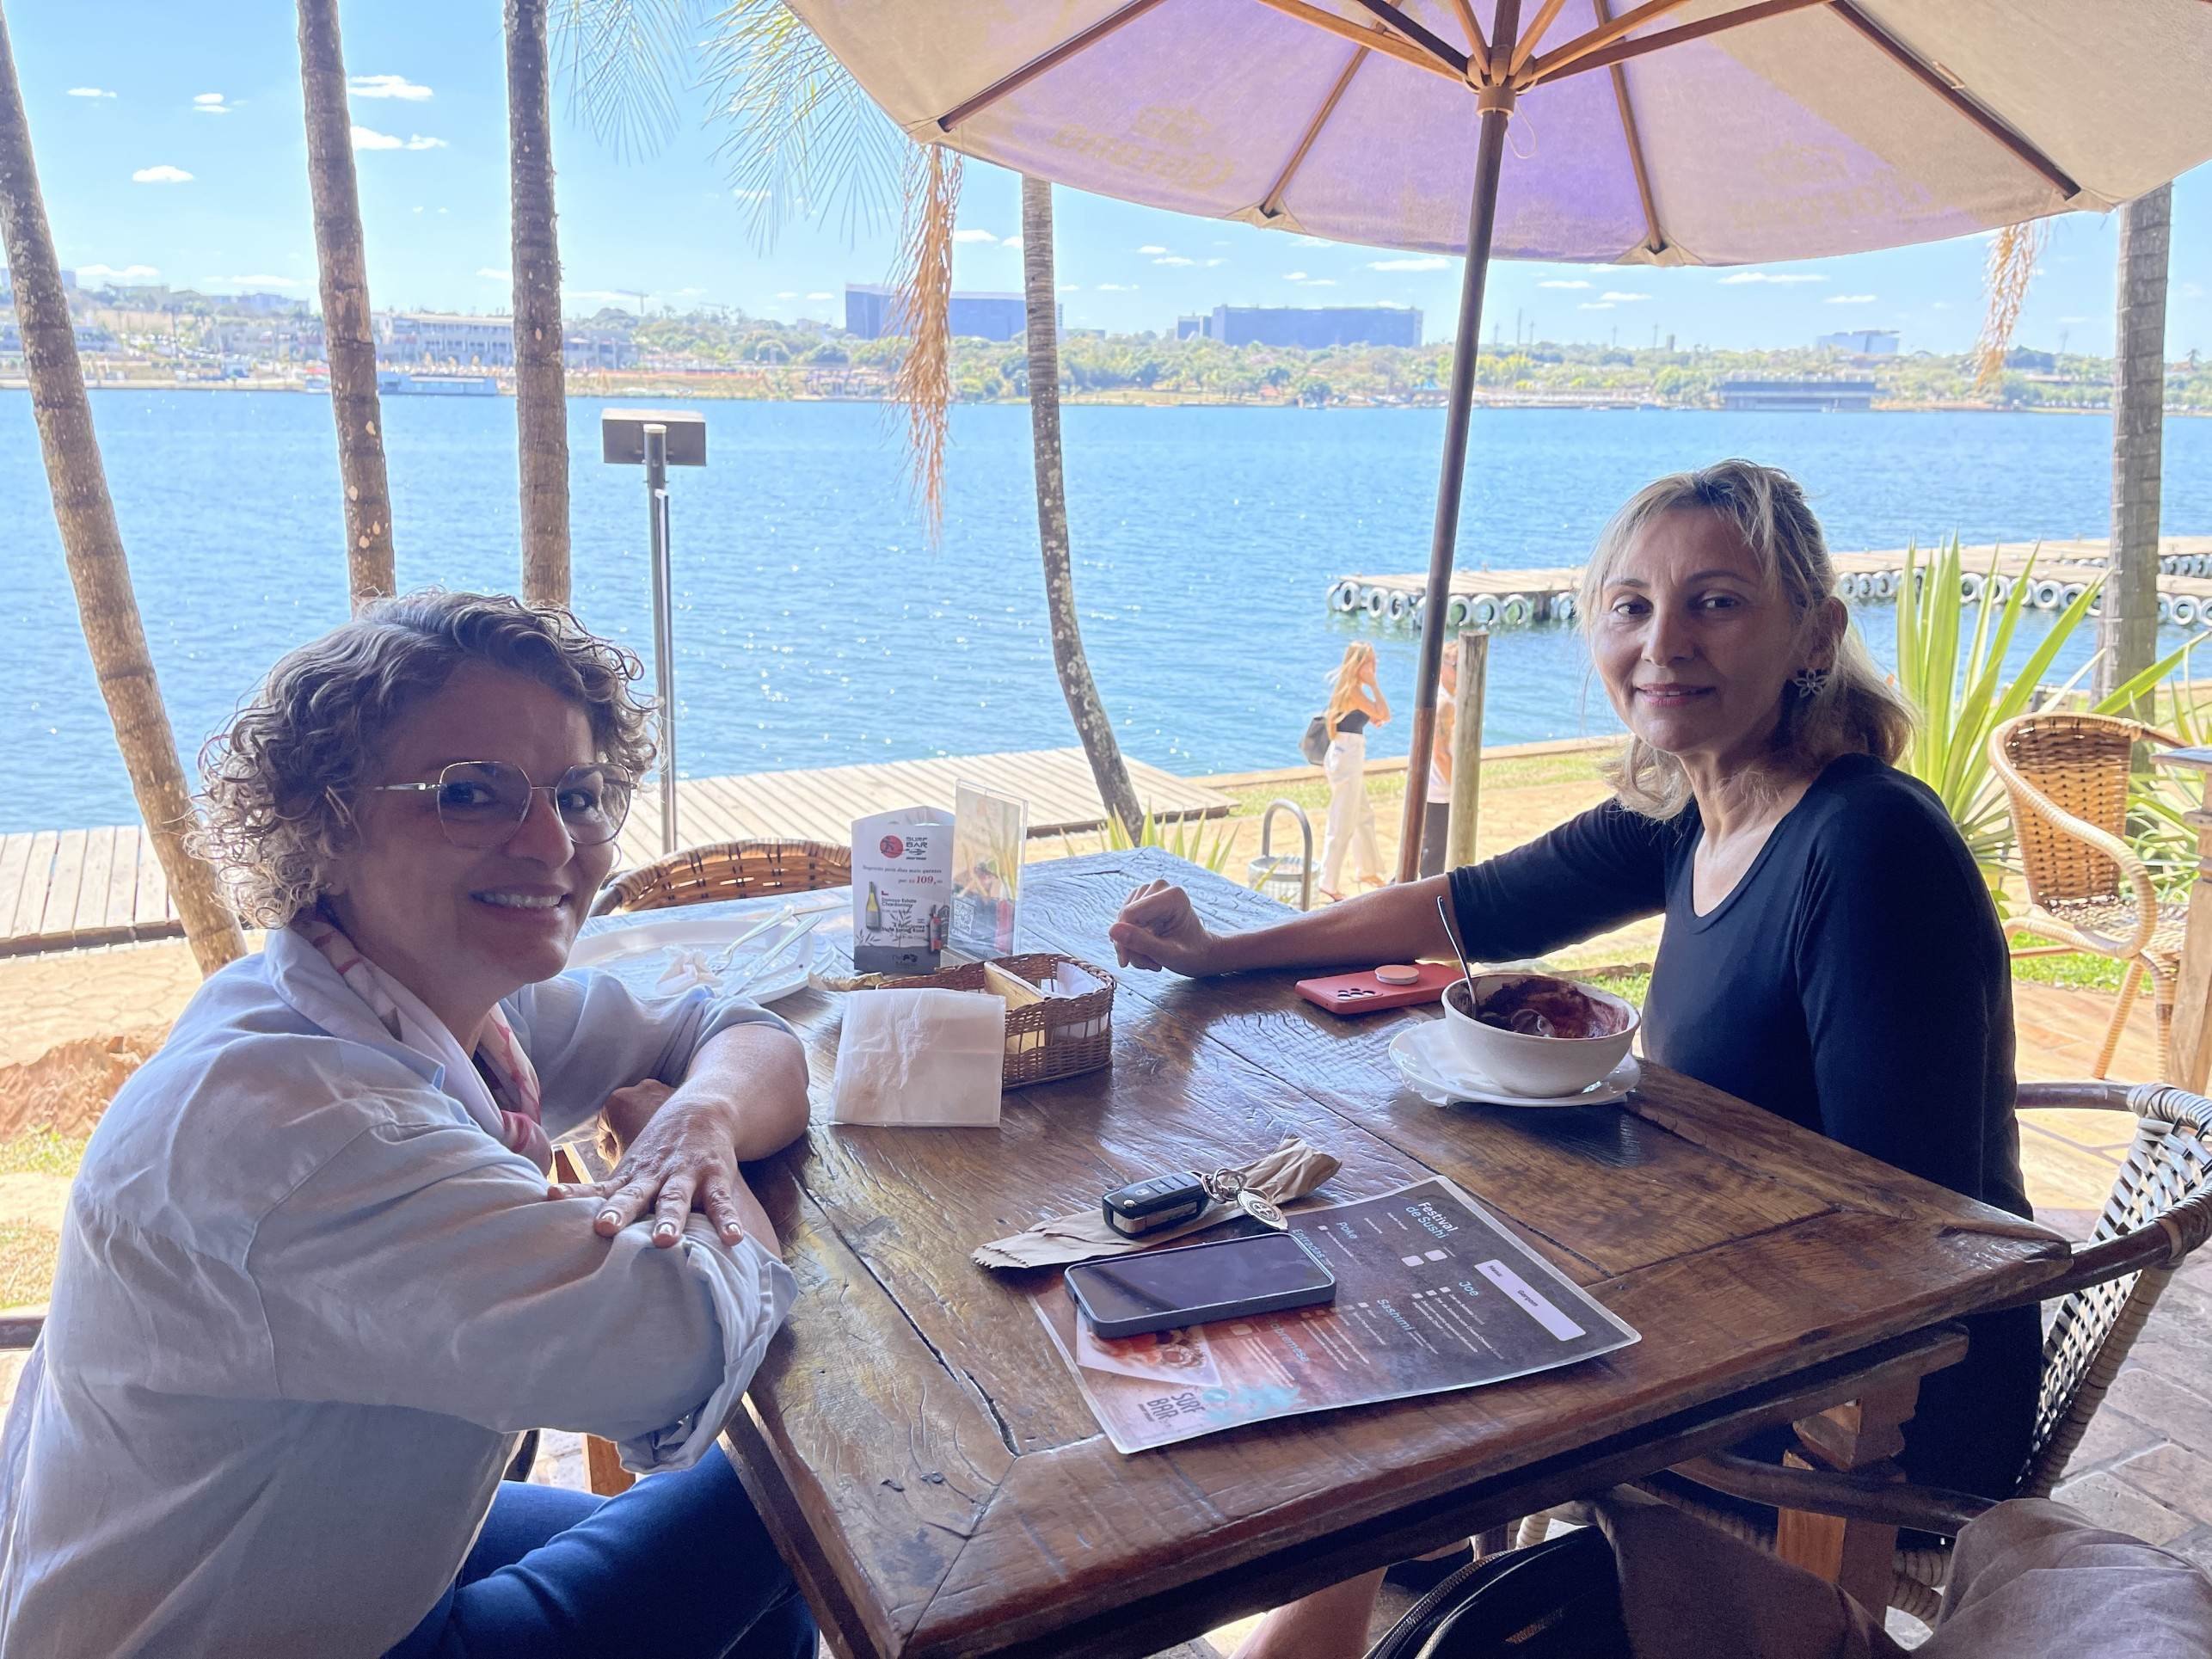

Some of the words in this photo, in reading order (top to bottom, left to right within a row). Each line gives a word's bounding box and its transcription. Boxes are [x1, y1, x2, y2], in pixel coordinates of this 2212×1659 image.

[1405, 1206, 1420, 1218] de
[1418, 1215, 1450, 1238] Sushi
[1418, 1201, 1459, 1232] Festival
[1292, 1228, 1325, 1258] Entradas
[1336, 1221, 1358, 1239] Poke
[1459, 1280, 1479, 1297] Joe
[1377, 1299, 1416, 1332] Sashimi
[1146, 1398, 1179, 1420] BAR
[1171, 1392, 1206, 1414] SURF
